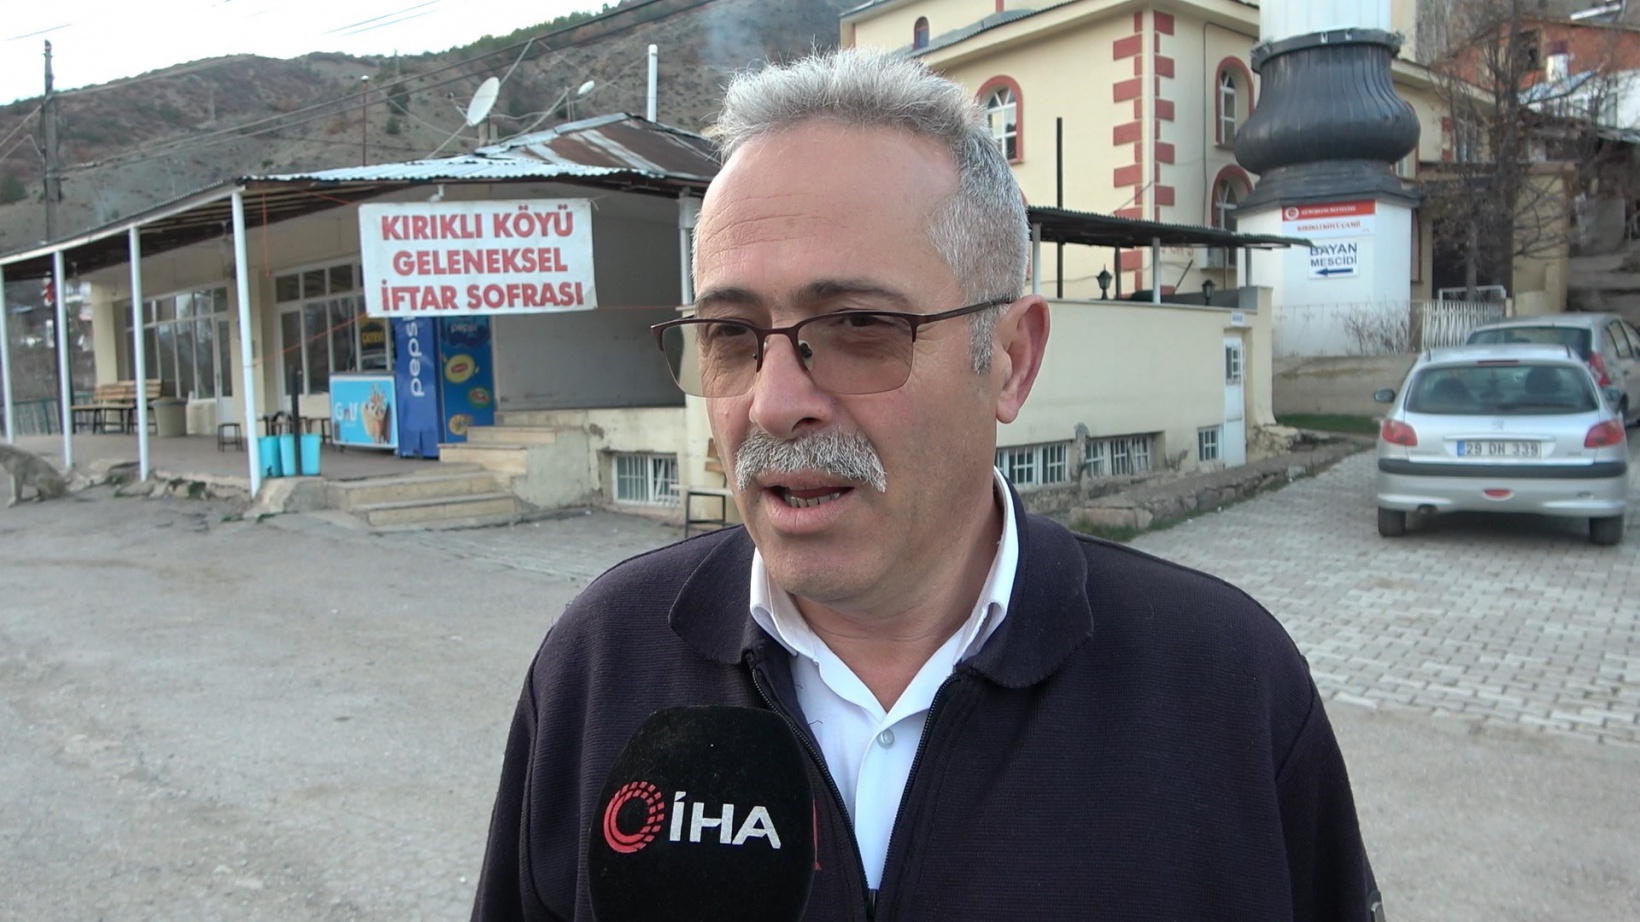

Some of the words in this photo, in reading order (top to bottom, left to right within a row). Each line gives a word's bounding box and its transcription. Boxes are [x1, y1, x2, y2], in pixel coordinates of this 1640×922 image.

[381, 213, 484, 240] KIRIKLI
[493, 204, 574, 239] KÖYÜ
[393, 247, 568, 276] GELENEKSEL
[1310, 255, 1358, 268] MESCİDİ
[381, 279, 459, 311] İFTAR
[466, 281, 585, 310] SOFRASI
[1466, 442, 1483, 455] 29
[1513, 442, 1539, 456] 339
[669, 791, 782, 850] İHA
